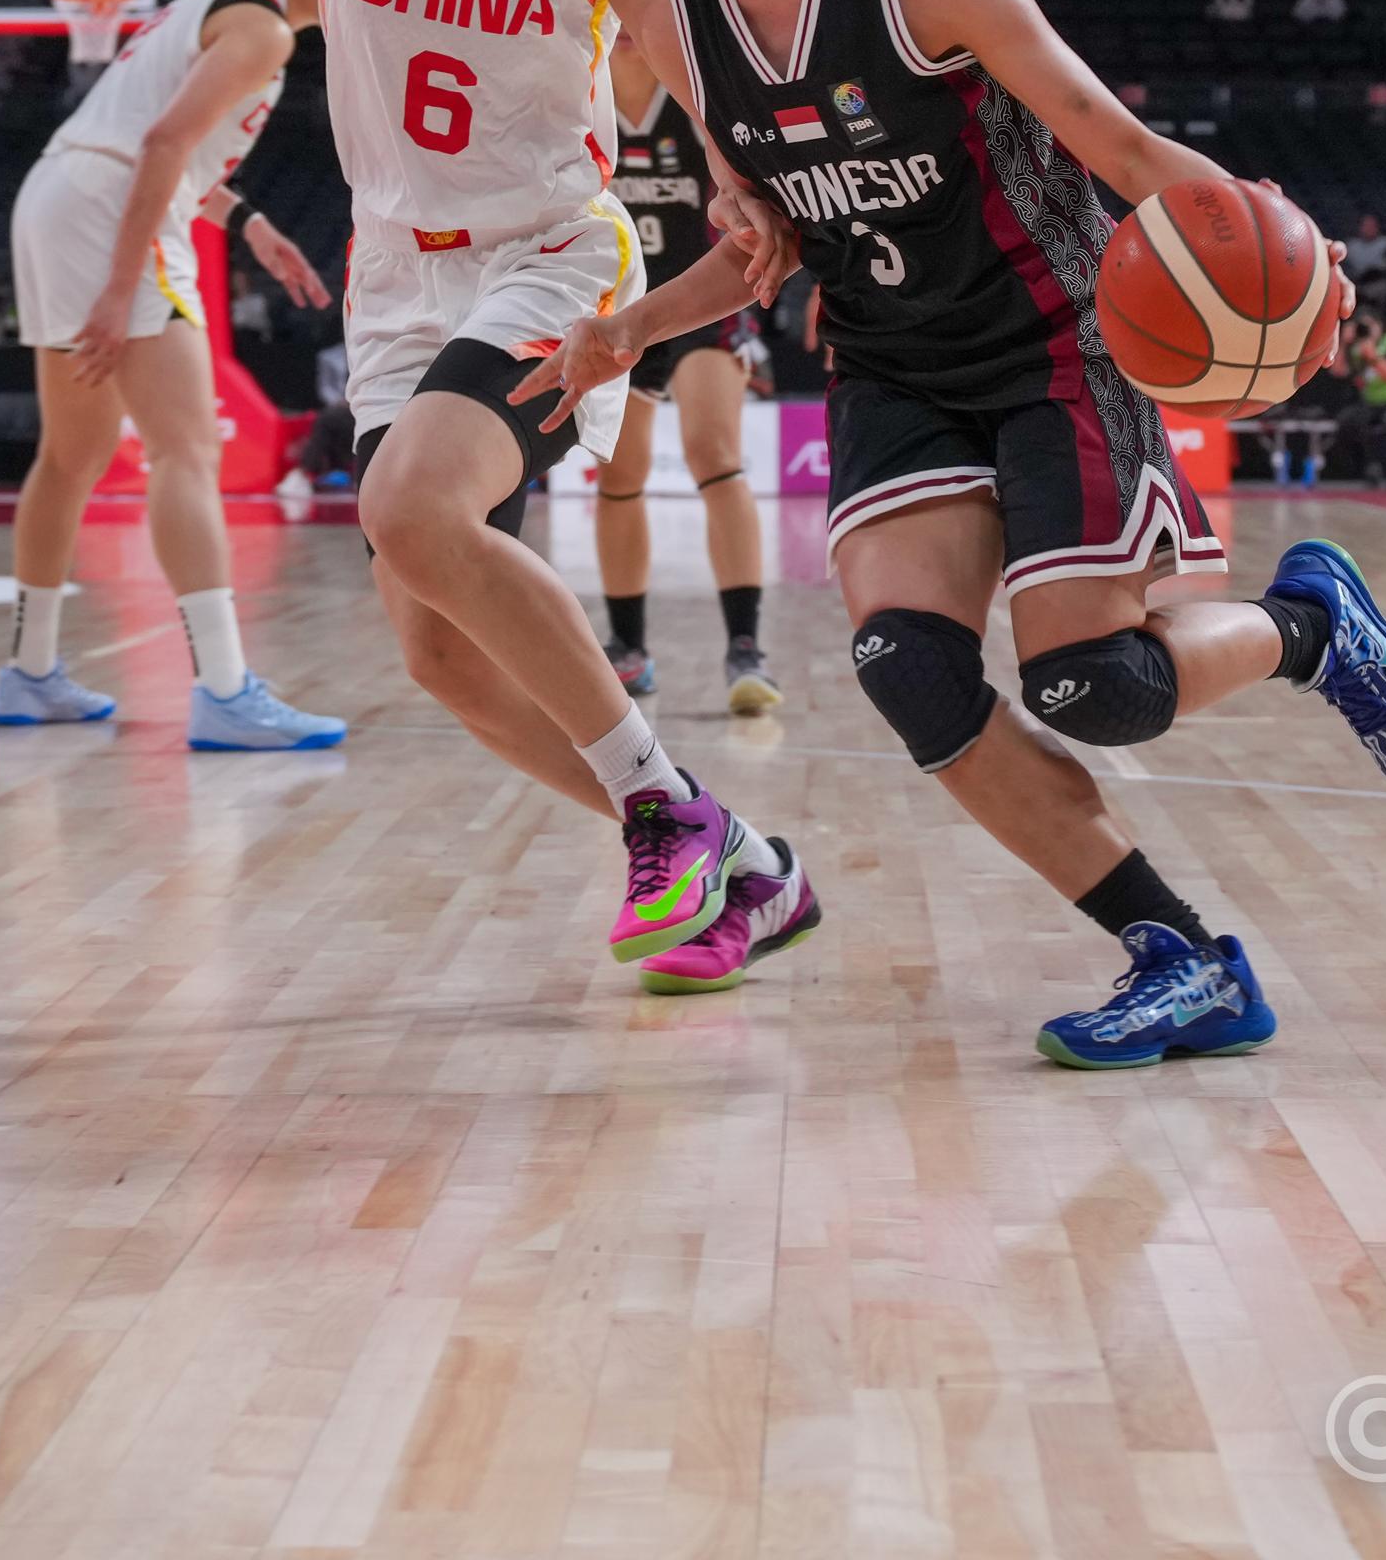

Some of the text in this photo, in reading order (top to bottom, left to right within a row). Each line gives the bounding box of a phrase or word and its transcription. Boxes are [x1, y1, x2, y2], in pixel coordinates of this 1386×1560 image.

[403, 50, 478, 155] 6
[846, 117, 876, 133] FIBA
[851, 221, 906, 286] 3
